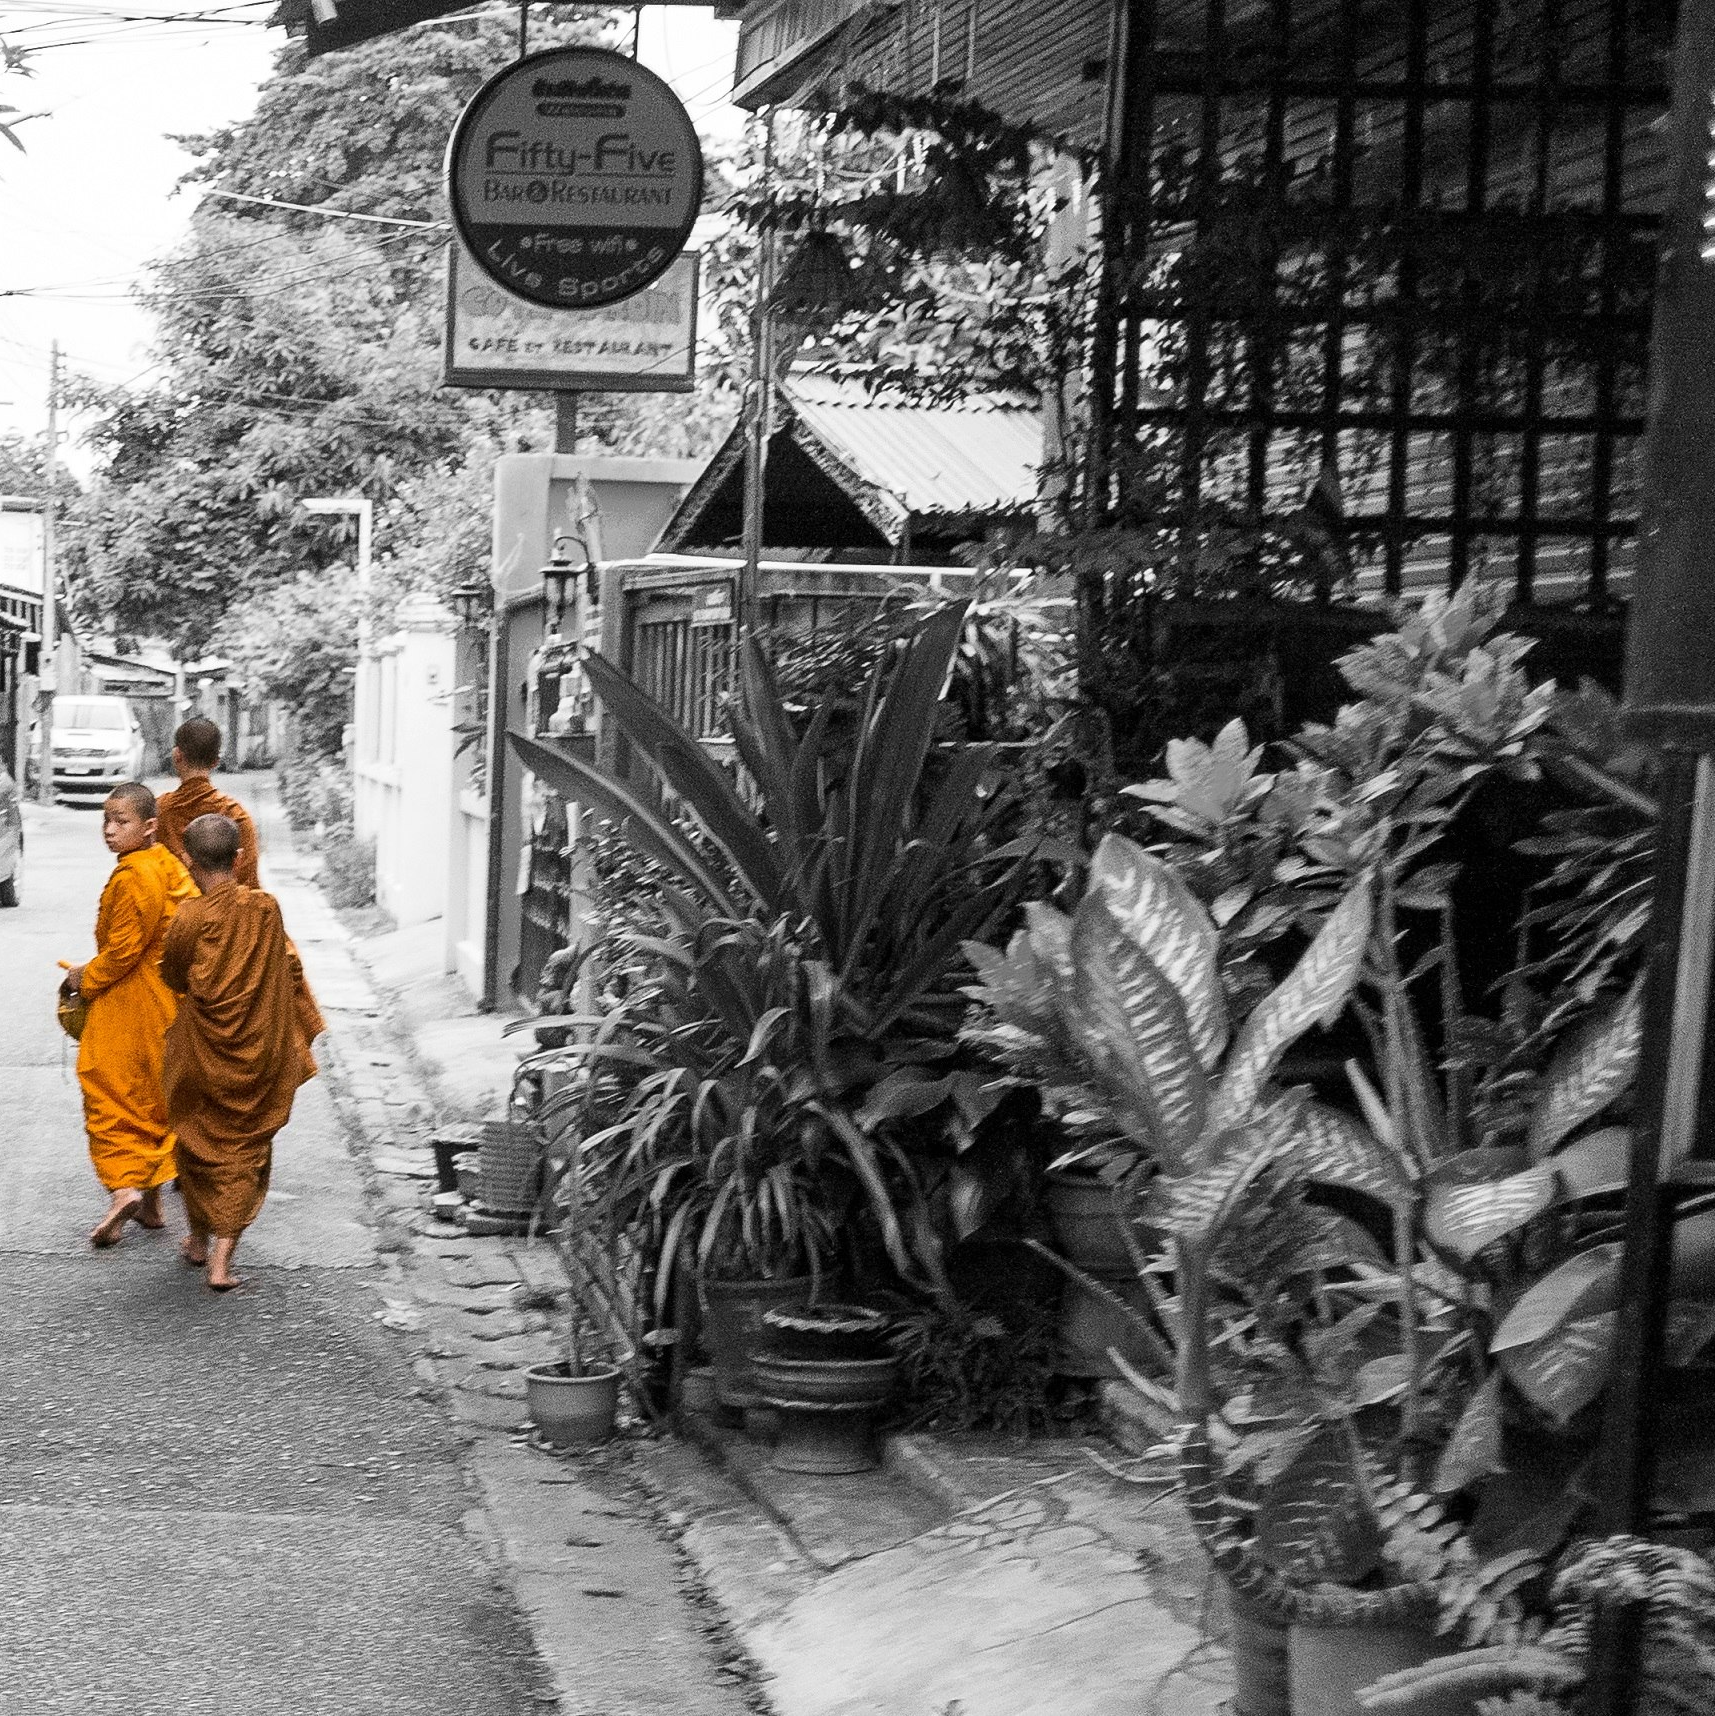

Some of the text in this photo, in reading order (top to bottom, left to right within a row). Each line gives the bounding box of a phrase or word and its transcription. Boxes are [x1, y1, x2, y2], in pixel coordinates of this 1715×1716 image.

[486, 130, 675, 176] Fifty-Five
[534, 232, 583, 254] Free
[487, 238, 666, 299] Live Sports
